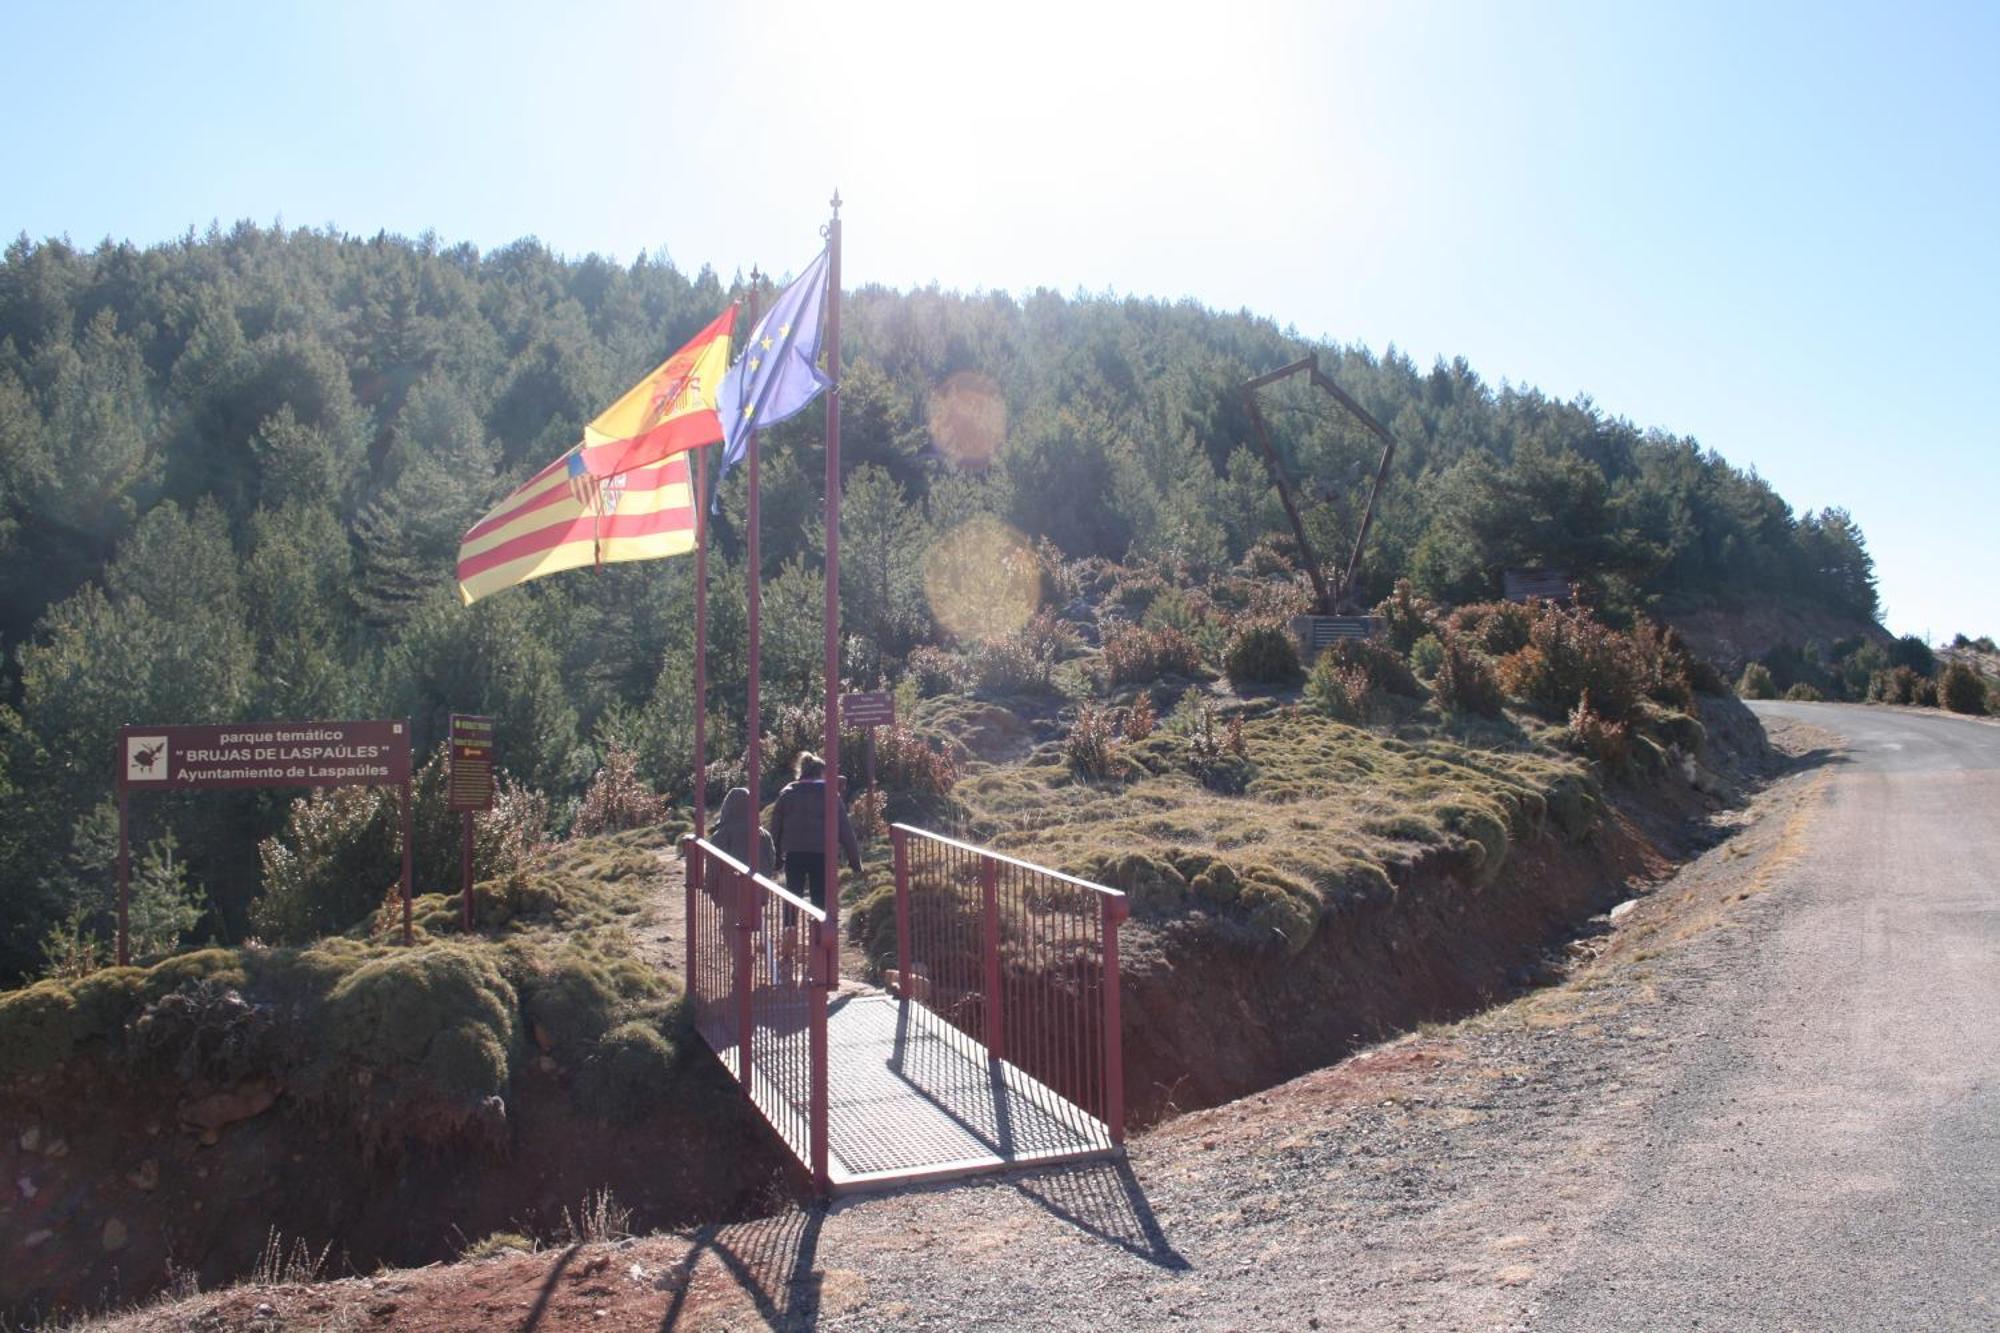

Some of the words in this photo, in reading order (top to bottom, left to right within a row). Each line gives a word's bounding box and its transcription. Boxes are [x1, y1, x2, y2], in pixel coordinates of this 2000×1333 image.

[220, 733, 273, 745] parque
[277, 729, 343, 741] temático
[186, 749, 252, 761] BRUJAS
[255, 748, 277, 760] DE
[280, 744, 378, 759] LASPAÚLES
[177, 767, 284, 782] Ayuntamiento
[286, 766, 305, 777] de
[308, 764, 388, 778] Laspaúles
